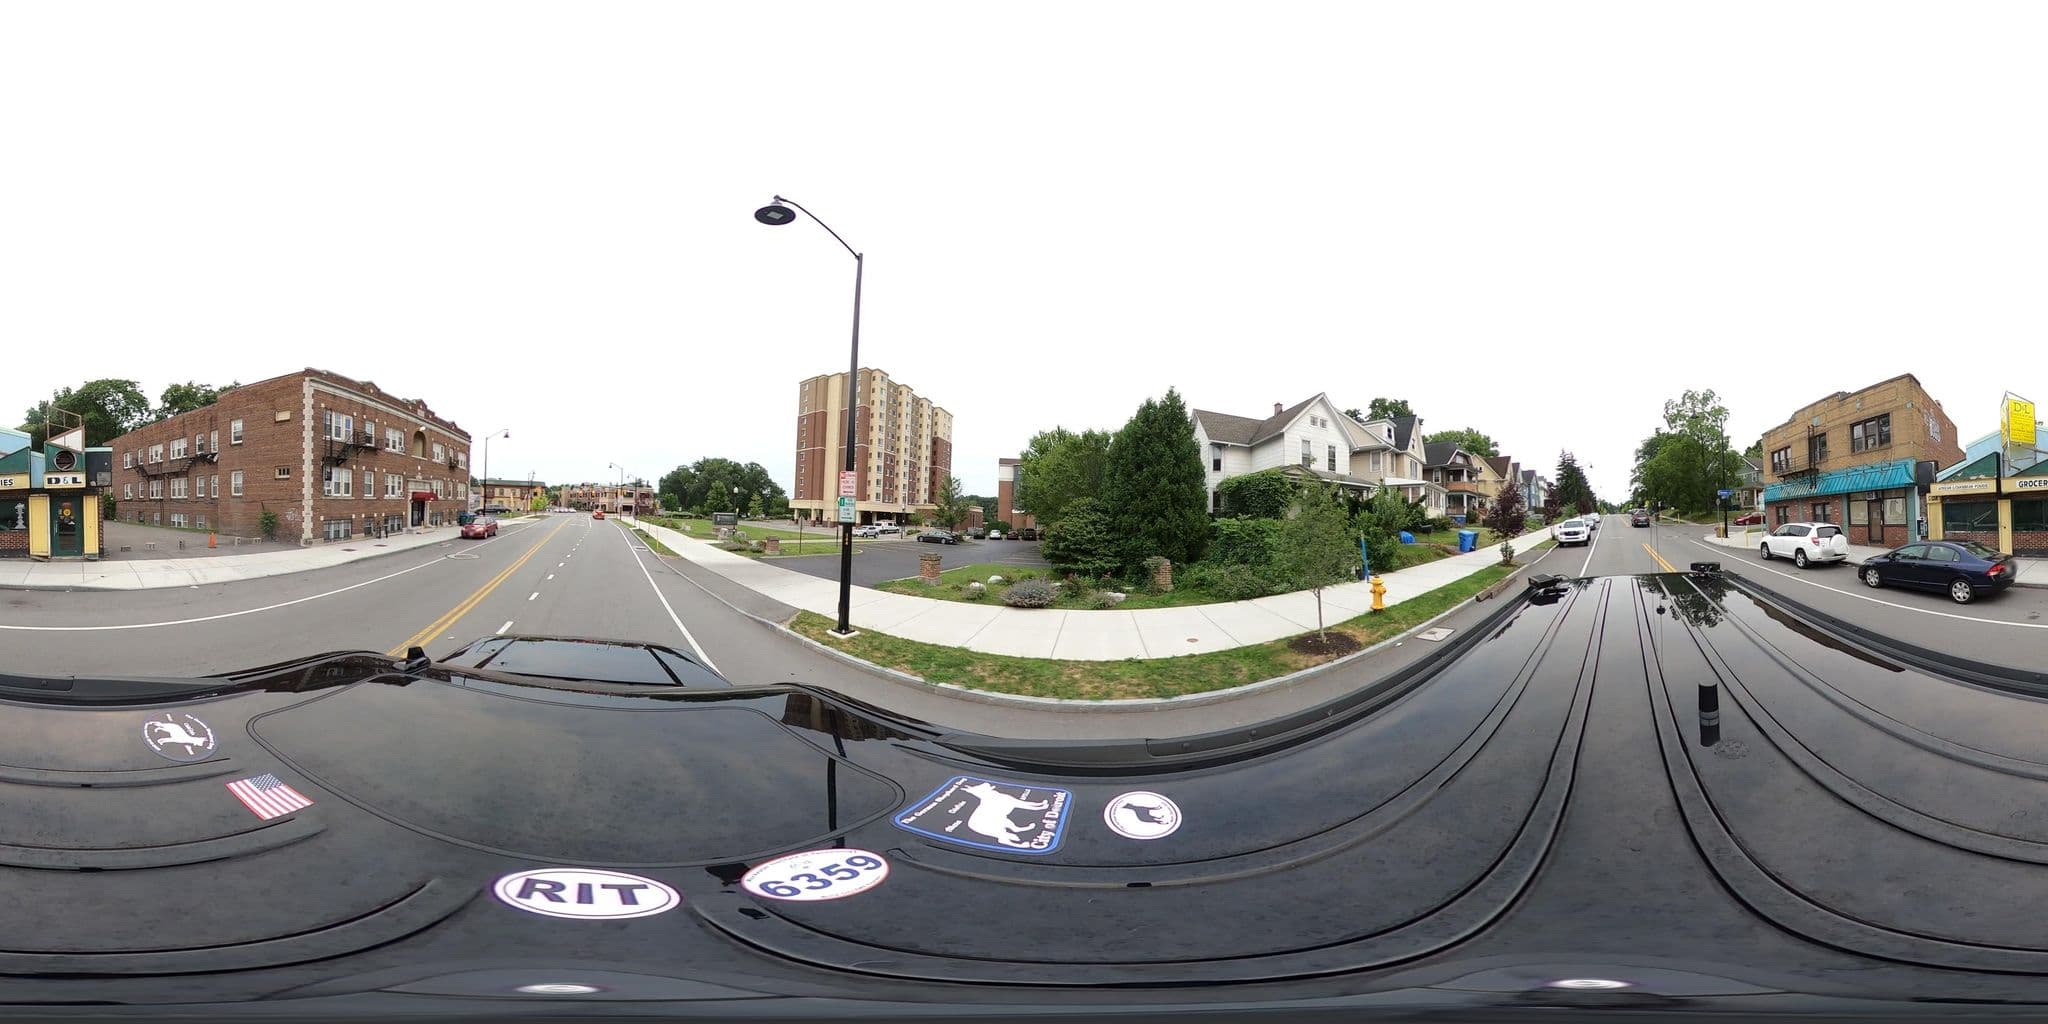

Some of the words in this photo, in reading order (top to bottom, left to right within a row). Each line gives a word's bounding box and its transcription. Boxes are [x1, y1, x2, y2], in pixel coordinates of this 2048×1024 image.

[2018, 479, 2048, 489] GROCER
[1042, 818, 1057, 830] of
[1030, 830, 1056, 849] City
[759, 855, 882, 897] 6359
[516, 877, 649, 906] RIT
